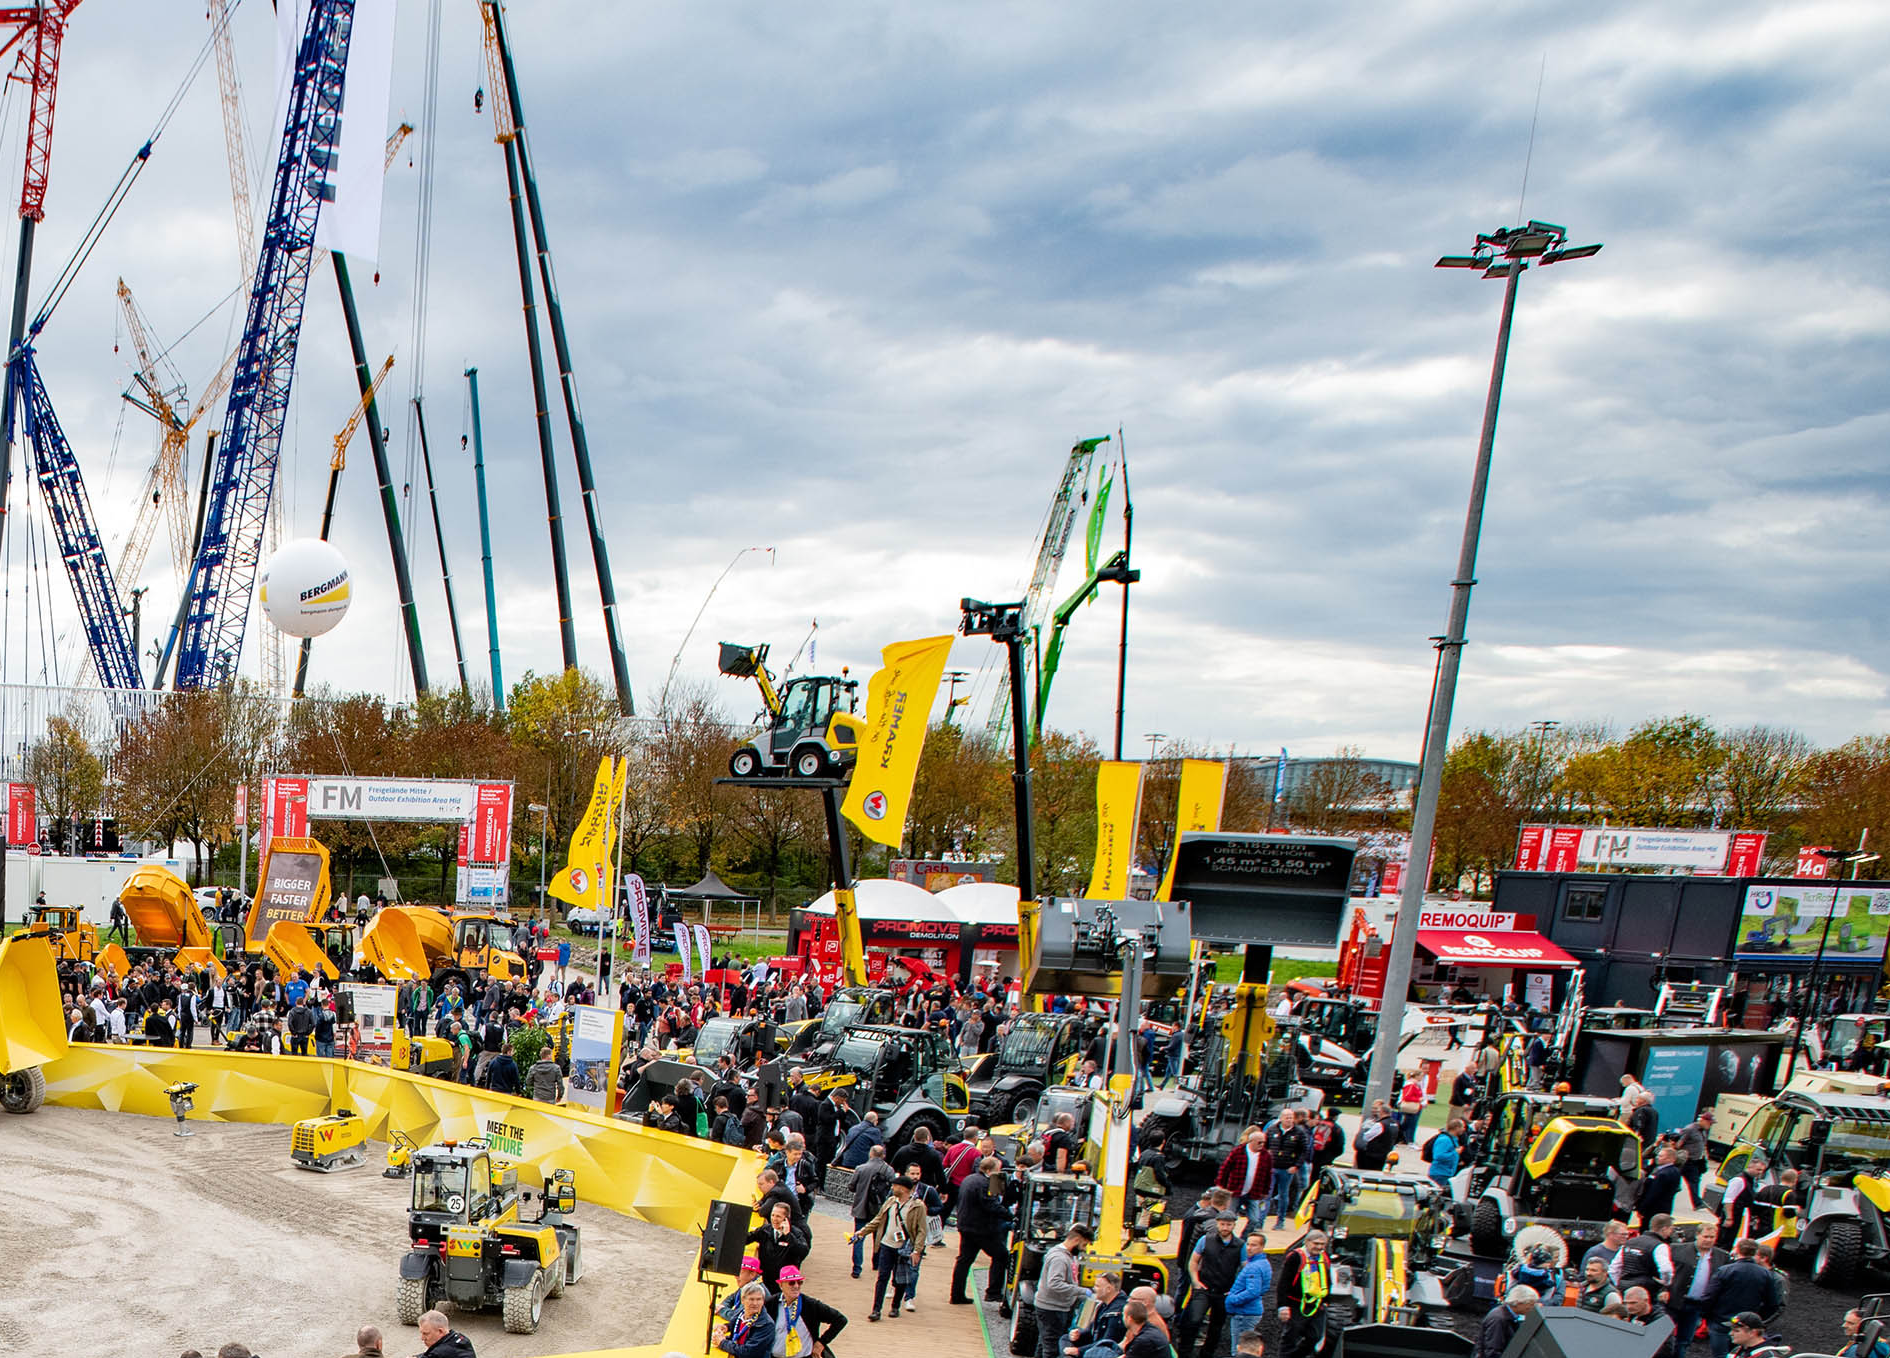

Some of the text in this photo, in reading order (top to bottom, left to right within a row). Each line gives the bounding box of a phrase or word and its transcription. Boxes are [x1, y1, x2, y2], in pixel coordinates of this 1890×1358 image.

[300, 569, 349, 602] BERGMANN
[323, 785, 361, 810] FM
[368, 786, 408, 796] Freigelände
[409, 787, 427, 795] Mitte
[368, 795, 462, 805] Outdoor Exhibition Area Mid
[27, 846, 40, 854] STOP
[889, 860, 907, 874] Cash
[914, 862, 950, 875] Cash
[1212, 864, 1319, 876] SCHAUFELINHALT
[1796, 858, 1825, 876] 14a
[273, 878, 312, 891] BIGGER
[270, 893, 308, 906] FASTER
[266, 908, 305, 922] BETTER
[1420, 912, 1505, 929] REMOQUIP
[874, 920, 960, 934] PROMOVE
[910, 932, 959, 940] DEMOLITION
[486, 1119, 525, 1141] MEET THE
[486, 1132, 524, 1157] FUTURE
[450, 1198, 461, 1210] 25
